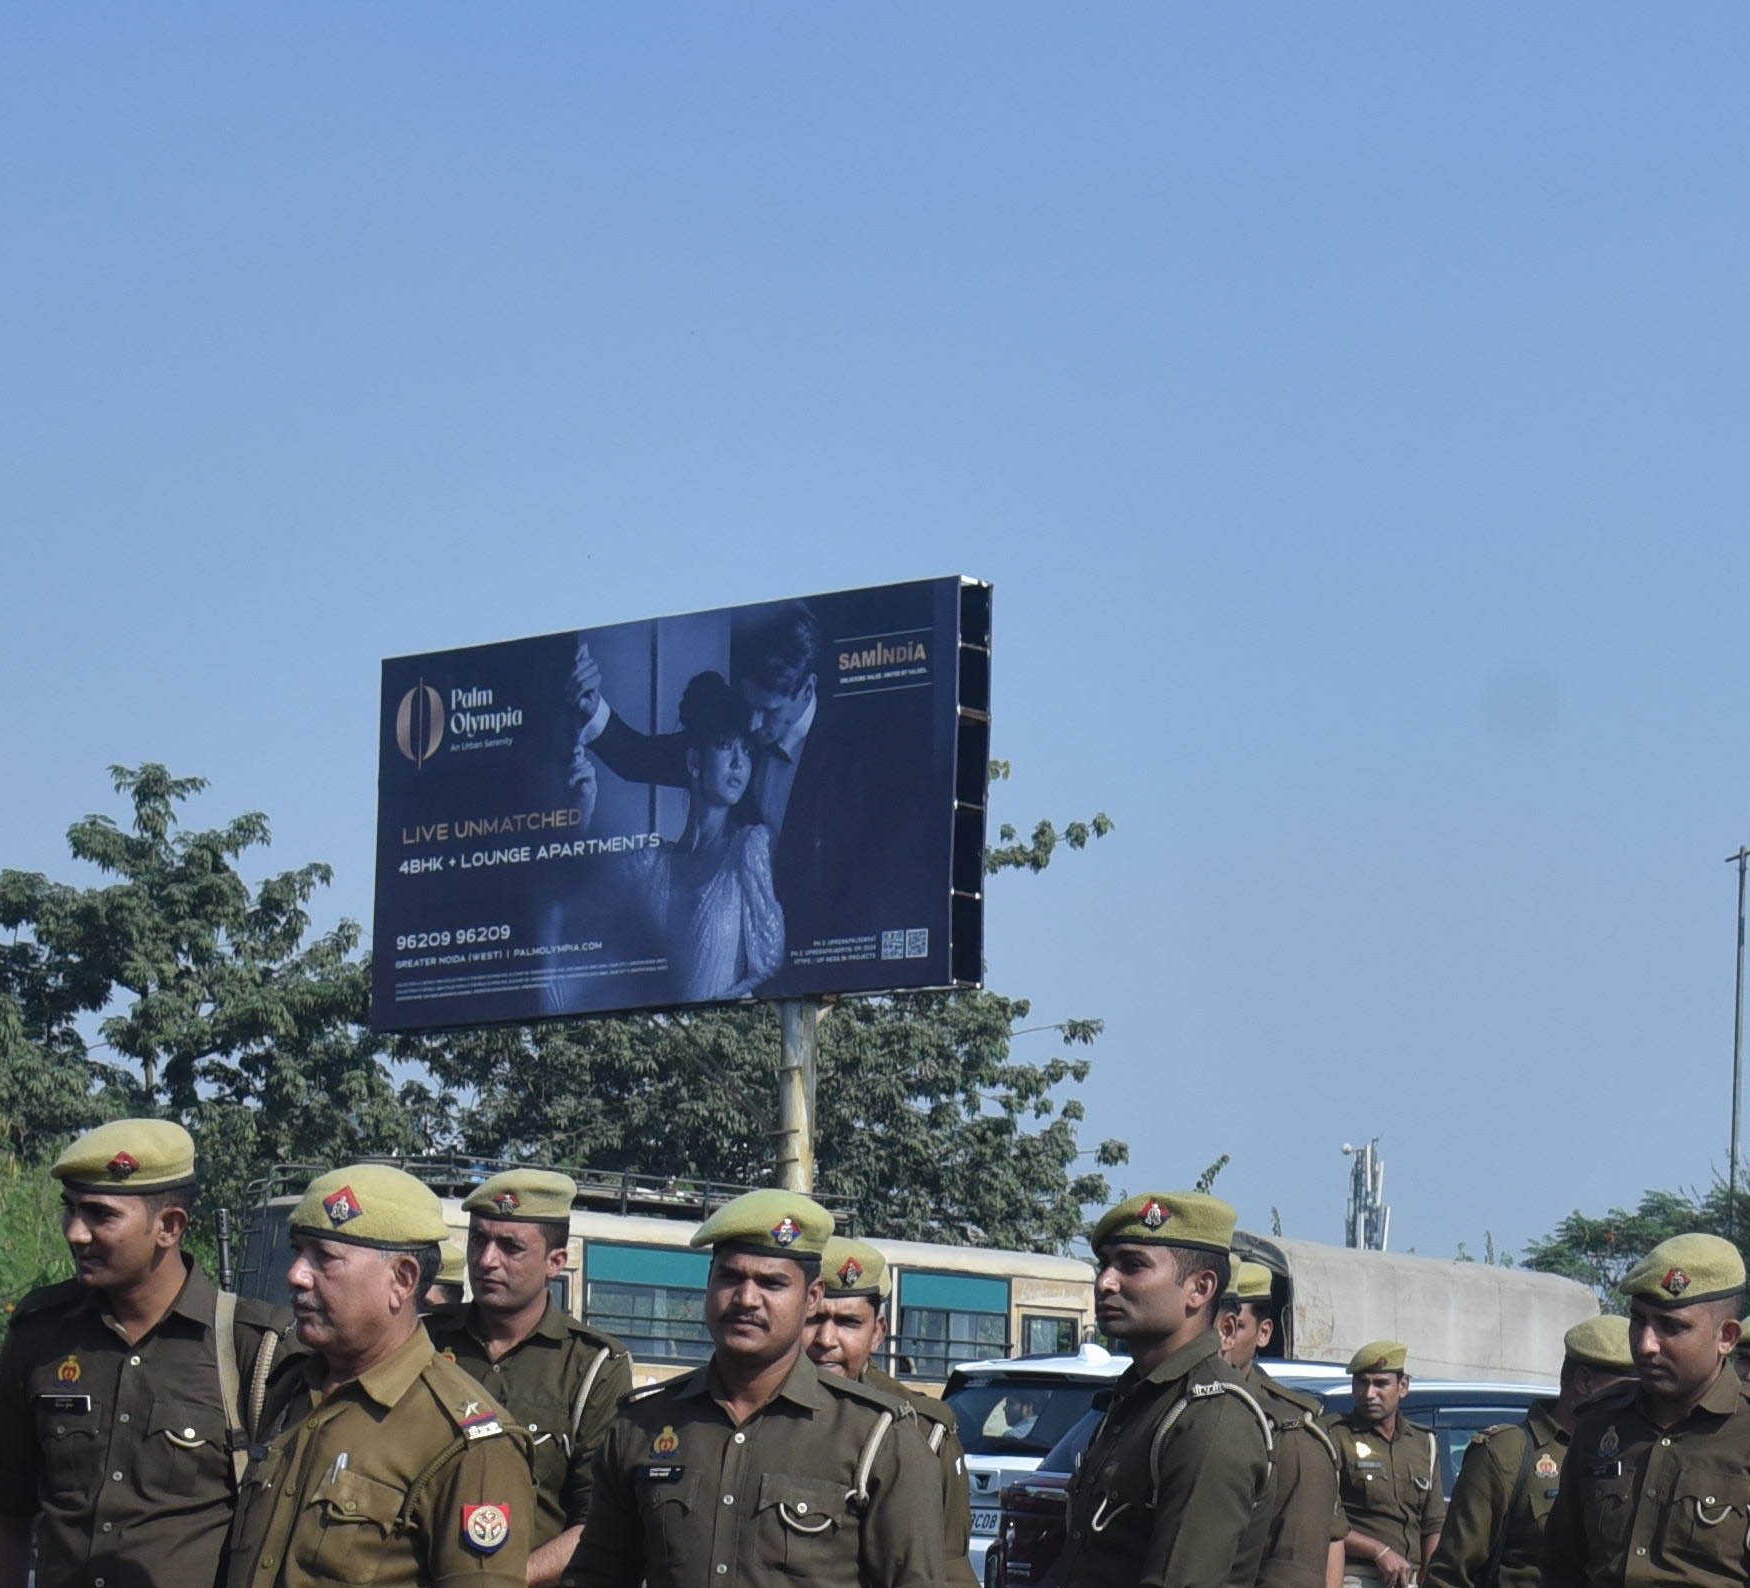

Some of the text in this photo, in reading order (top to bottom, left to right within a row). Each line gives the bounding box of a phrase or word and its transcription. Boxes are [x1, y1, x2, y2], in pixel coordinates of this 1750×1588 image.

[451, 686, 493, 711] Palm
[450, 706, 523, 738] Olympia
[402, 808, 582, 844] LIVE UNMATCHED
[399, 856, 443, 875] 4BHK
[461, 846, 531, 868] LOUNGE
[536, 832, 661, 861] APARTMENTS
[396, 924, 511, 951] 96209 96209
[395, 957, 437, 970] GREATER
[468, 950, 503, 965] (WEST)
[513, 941, 603, 959] PALMOLYMPIA.COM
